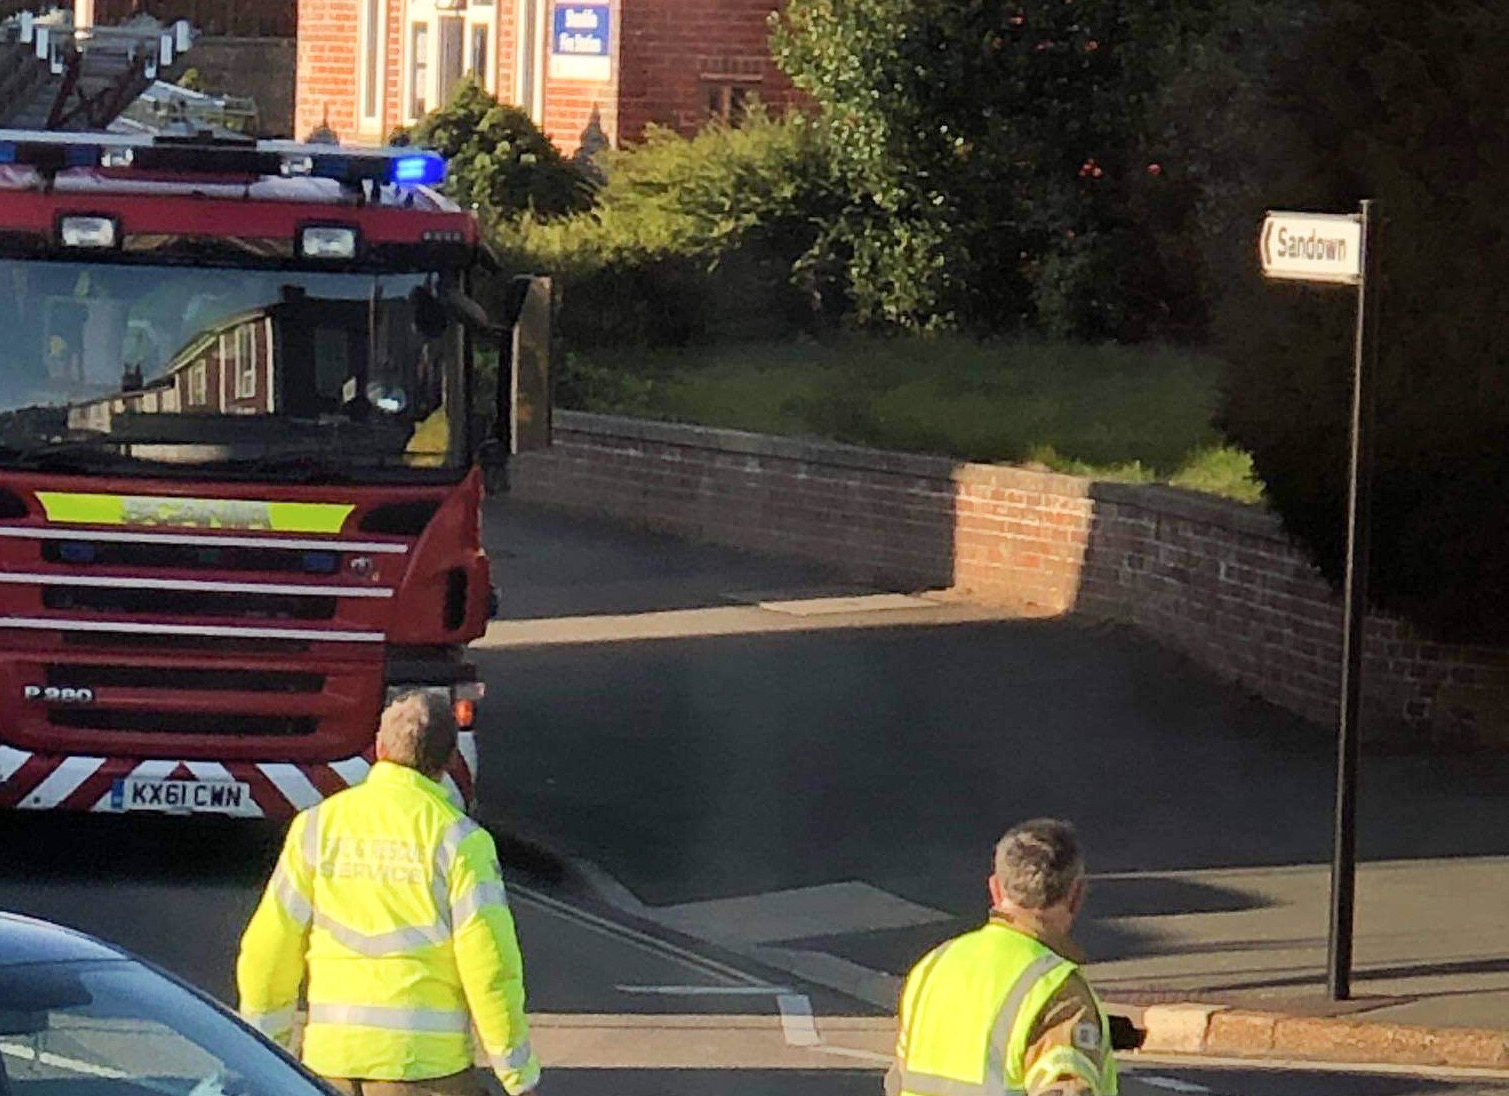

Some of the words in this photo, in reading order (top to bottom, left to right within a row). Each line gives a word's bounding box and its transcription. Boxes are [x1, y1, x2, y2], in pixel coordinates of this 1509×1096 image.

[1277, 226, 1346, 262] Sandown
[131, 782, 187, 805] KX61
[193, 784, 242, 807] CWN
[320, 860, 424, 884] SERVICE
